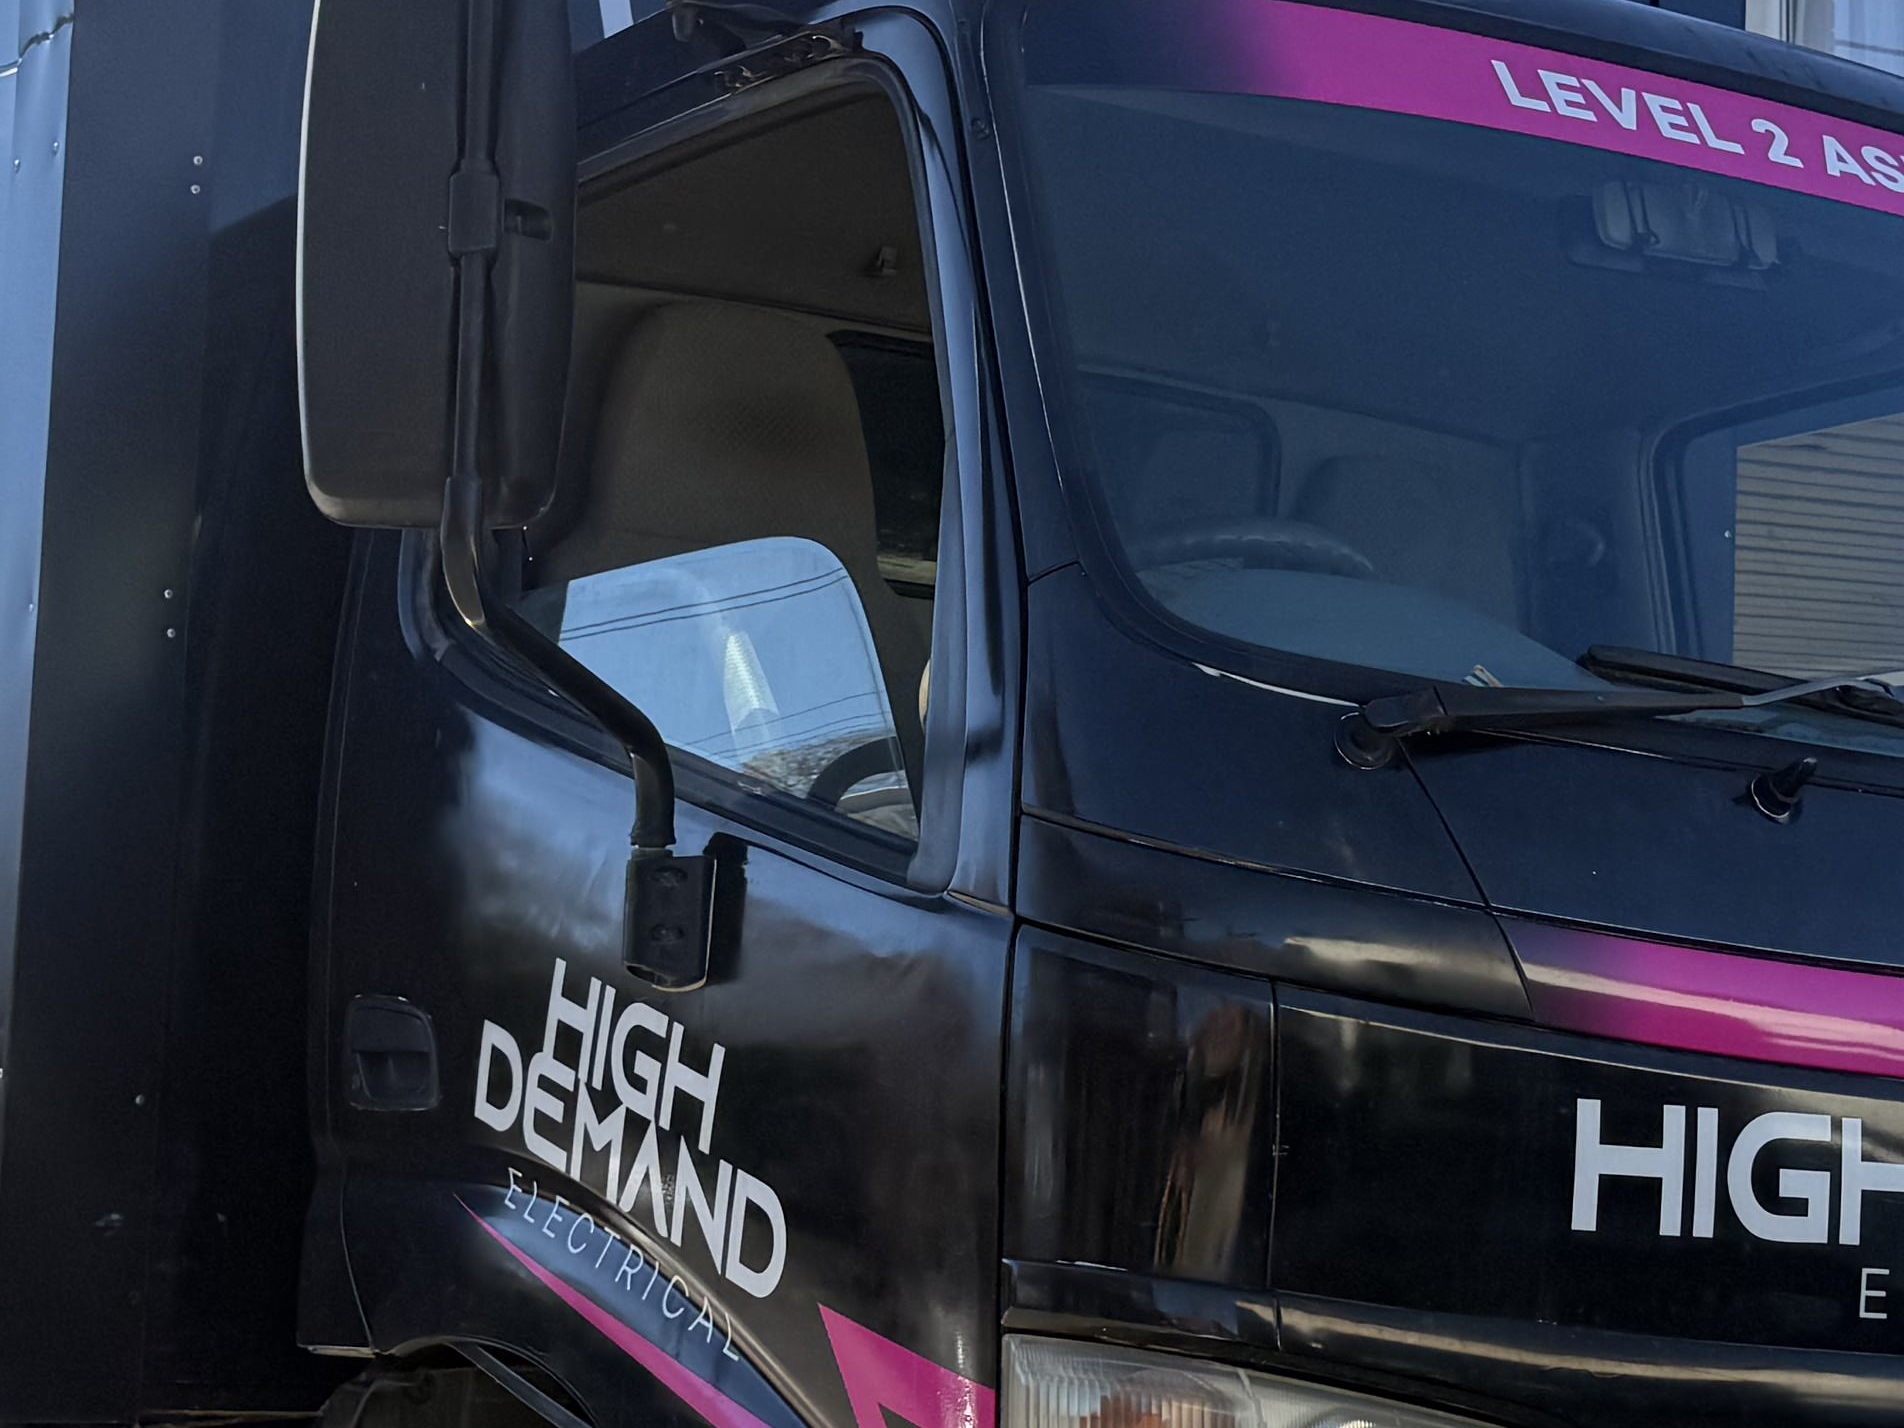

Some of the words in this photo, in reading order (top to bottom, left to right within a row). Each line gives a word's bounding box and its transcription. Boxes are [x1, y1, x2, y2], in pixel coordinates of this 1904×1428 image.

[1490, 59, 1745, 155] LEVEL
[1751, 118, 1804, 169] 2
[542, 956, 726, 1155] HIGH
[473, 1018, 788, 1299] DEMAND
[502, 1166, 741, 1363] ELECTRICAL
